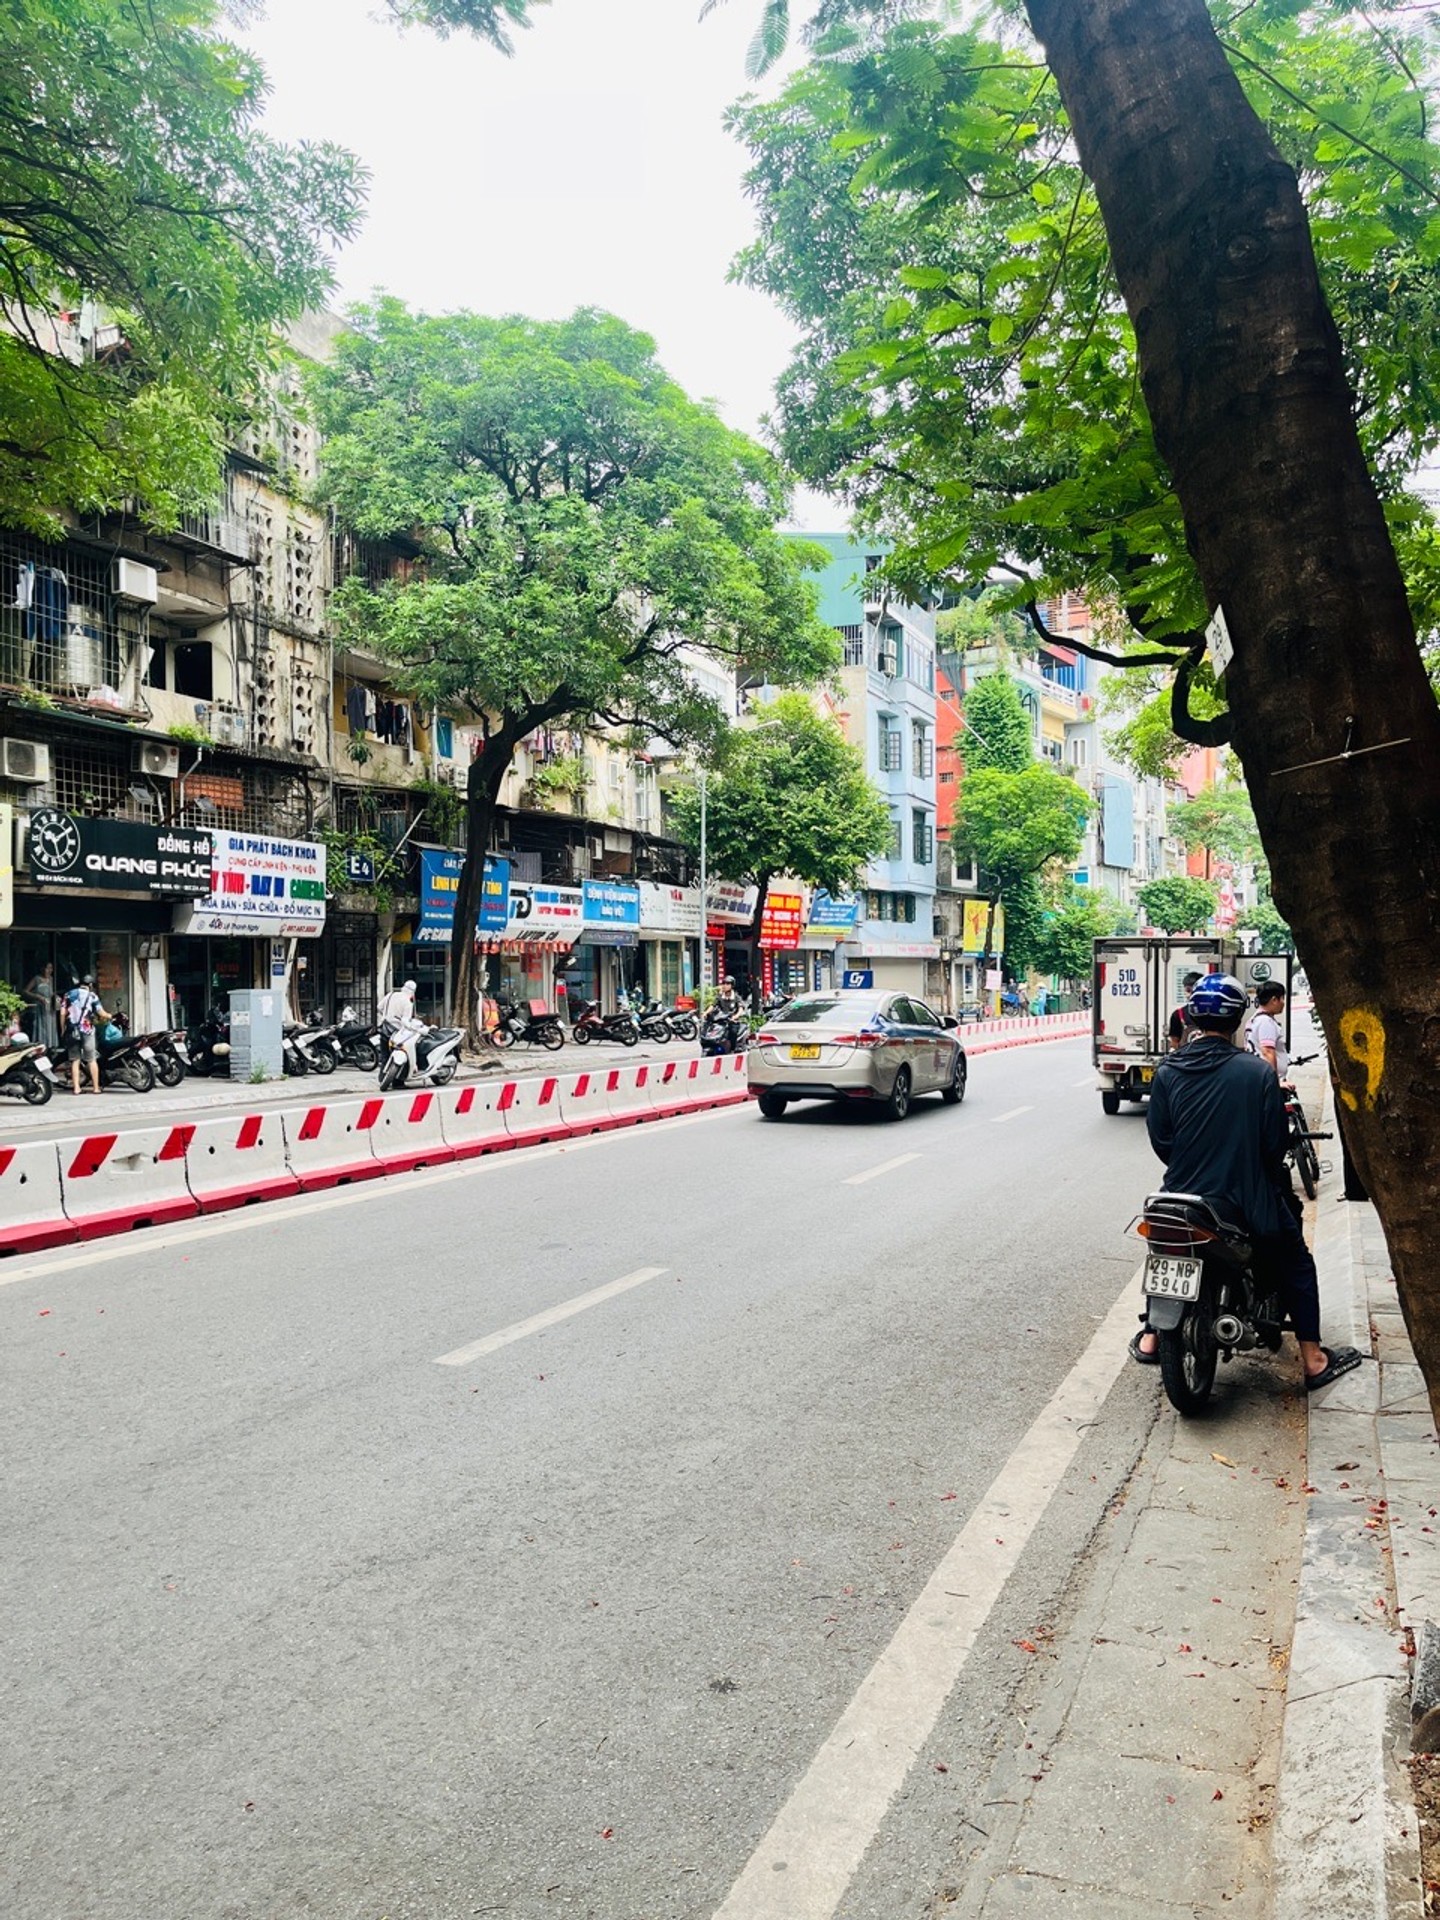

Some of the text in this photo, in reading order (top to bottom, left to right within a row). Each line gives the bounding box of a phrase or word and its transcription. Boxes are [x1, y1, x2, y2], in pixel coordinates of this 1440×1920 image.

[157, 833, 210, 855] ĐỒNG HỒ
[228, 838, 317, 860] GIA PHÁT BÁCH KHOA
[85, 854, 211, 878] QUANG PHÚC
[290, 878, 325, 900] CAMERA
[221, 898, 236, 909] BÁN
[243, 898, 257, 911] SỬA
[259, 902, 279, 914] CHỮA
[314, 907, 321, 915] IN
[1118, 969, 1136, 982] 51D
[1111, 983, 1141, 997] 612.13
[1150, 1276, 1189, 1295] 5940
